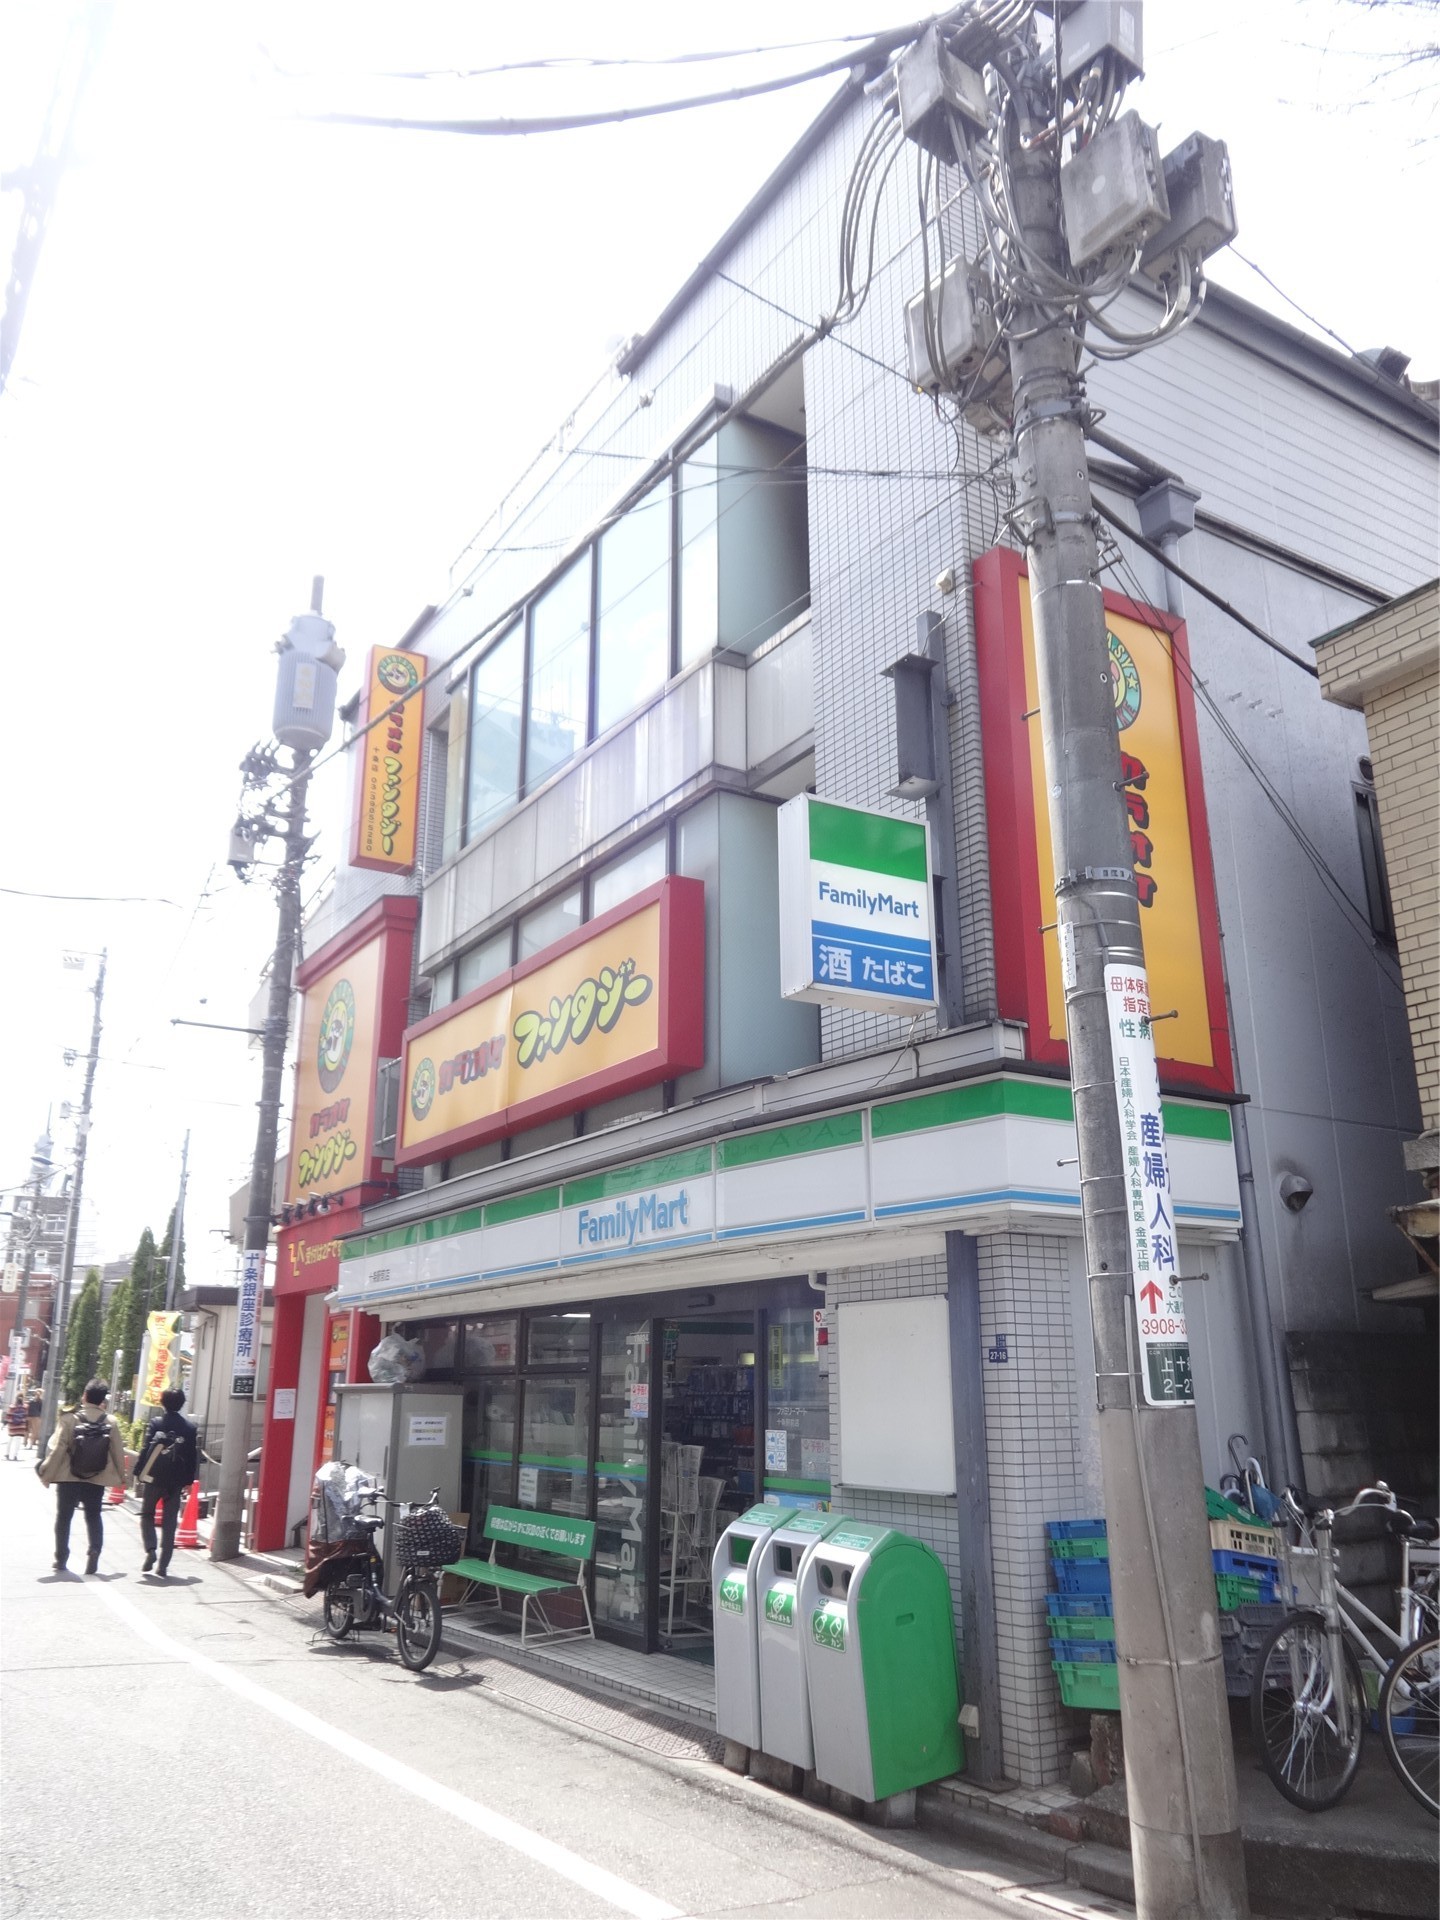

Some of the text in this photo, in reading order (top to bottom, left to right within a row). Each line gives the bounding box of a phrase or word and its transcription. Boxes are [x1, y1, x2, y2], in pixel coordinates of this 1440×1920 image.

[818, 880, 920, 918] FamilyMart
[818, 943, 926, 990] 酒 たばこ
[438, 956, 654, 1096] カラオケ ファンタジー
[309, 1097, 351, 1140] カラオケ
[1119, 1056, 1138, 1142] 日本産婦人科学会
[298, 1129, 358, 1189] ファンタジー
[1127, 1145, 1146, 1222] 産婦人科専門医
[577, 1187, 689, 1246] FamilyMart
[1139, 1112, 1175, 1272] 産婦人科
[236, 1252, 260, 1358] 十条銀座診療所
[990, 1351, 1007, 1360] 27-16
